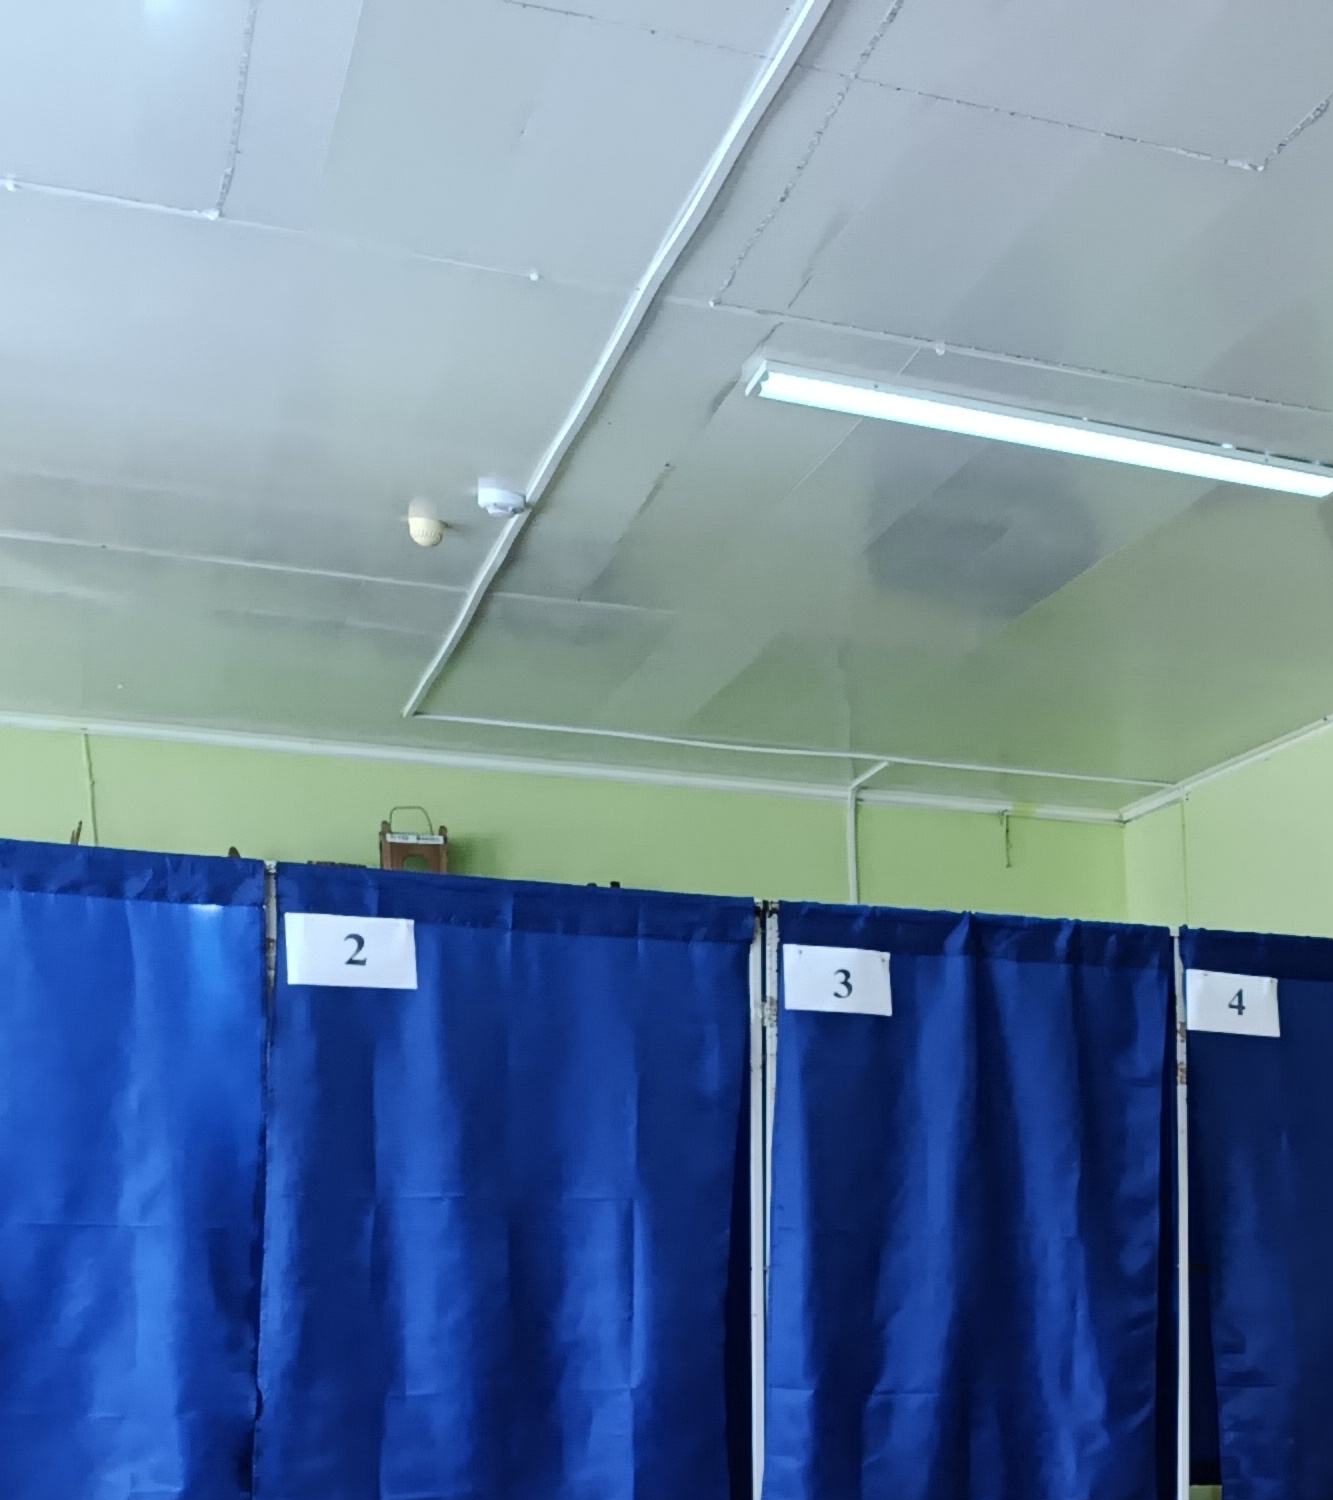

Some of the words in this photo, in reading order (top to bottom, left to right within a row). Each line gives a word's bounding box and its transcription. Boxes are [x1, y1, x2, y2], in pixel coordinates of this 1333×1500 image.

[344, 934, 367, 966] 2
[832, 968, 853, 1000] 3
[1228, 989, 1245, 1016] 4
